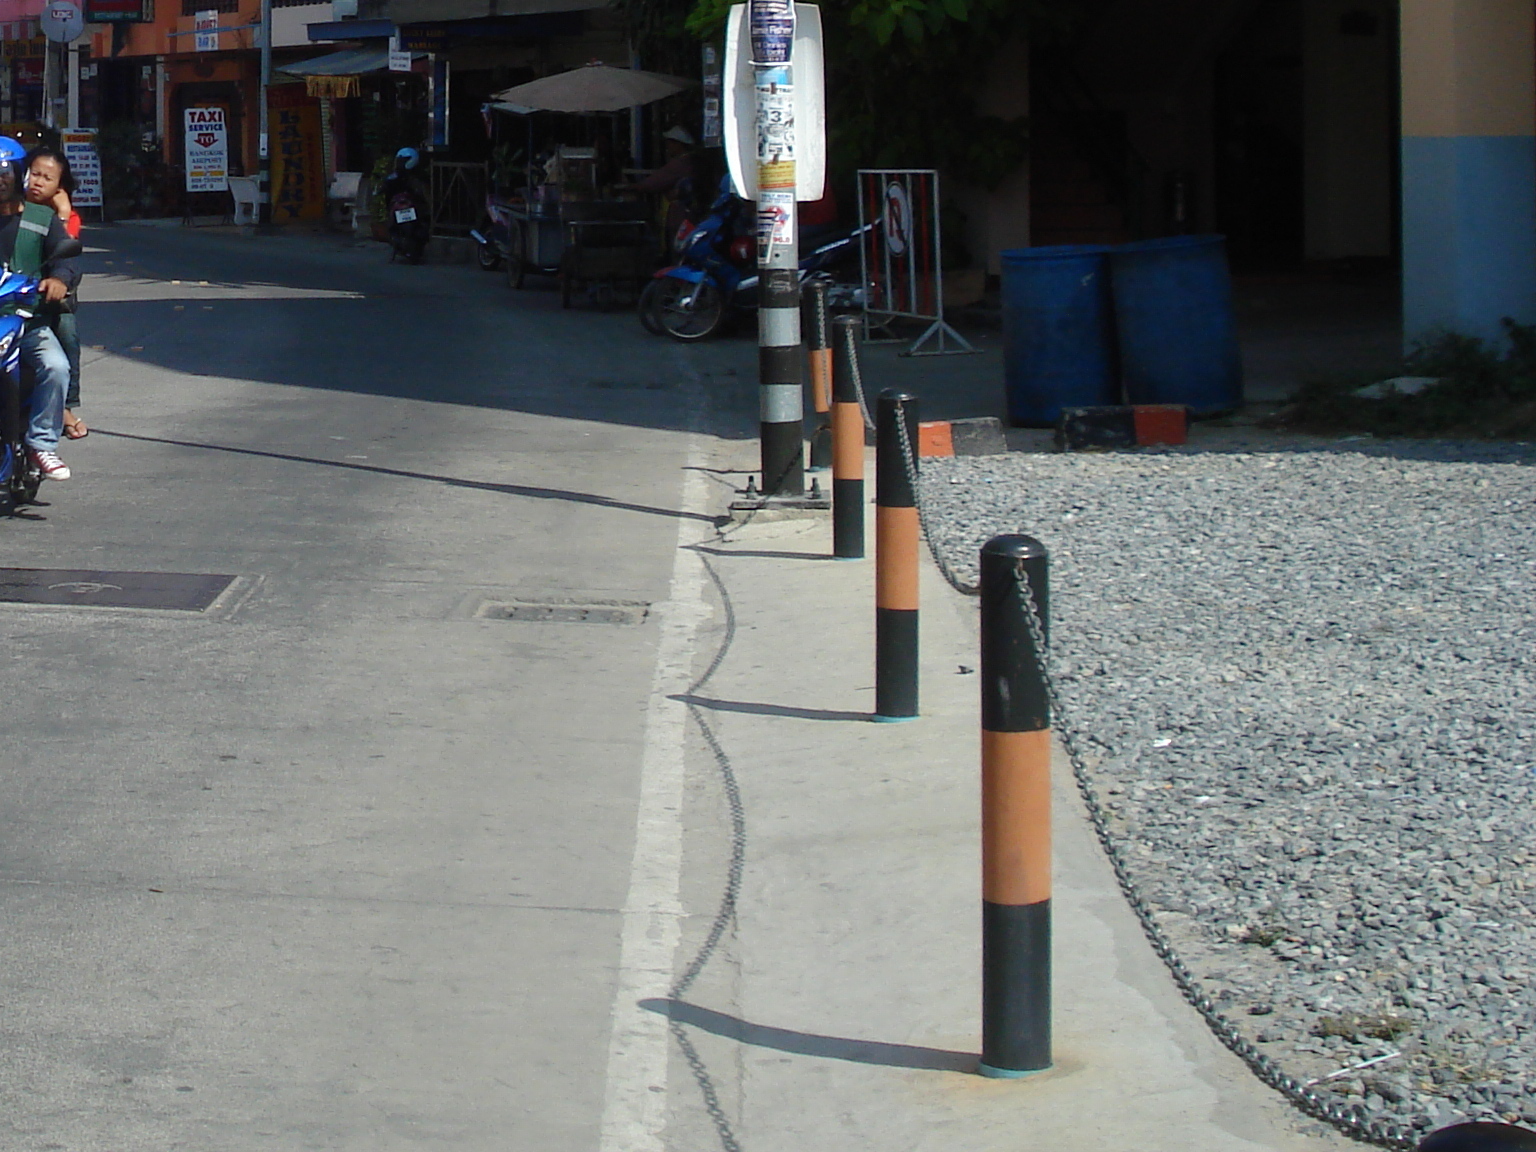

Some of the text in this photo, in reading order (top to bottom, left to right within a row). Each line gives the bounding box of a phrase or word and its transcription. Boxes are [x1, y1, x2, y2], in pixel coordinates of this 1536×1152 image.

[189, 111, 223, 123] TAXI
[188, 123, 223, 132] SERVICE
[199, 135, 214, 144] TO
